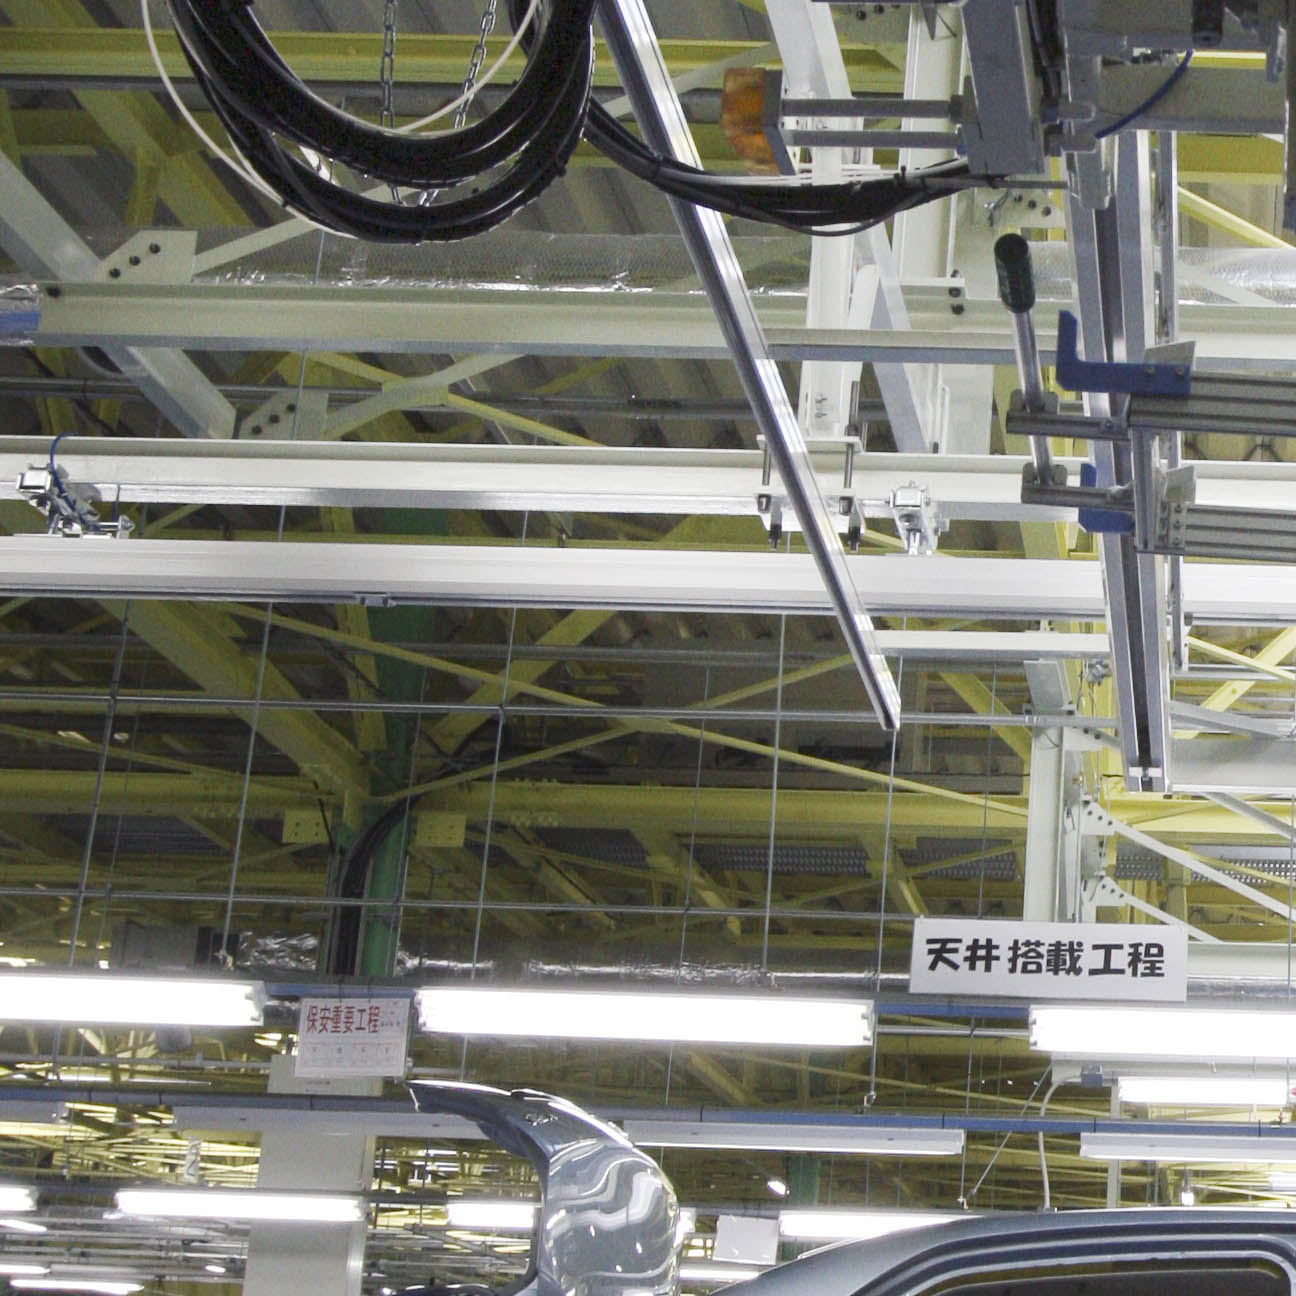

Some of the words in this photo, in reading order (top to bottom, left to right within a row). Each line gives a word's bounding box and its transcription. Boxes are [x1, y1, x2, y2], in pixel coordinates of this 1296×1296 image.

[926, 937, 1165, 977] 天井搭載工程
[306, 1005, 381, 1033] 保安重要工程
